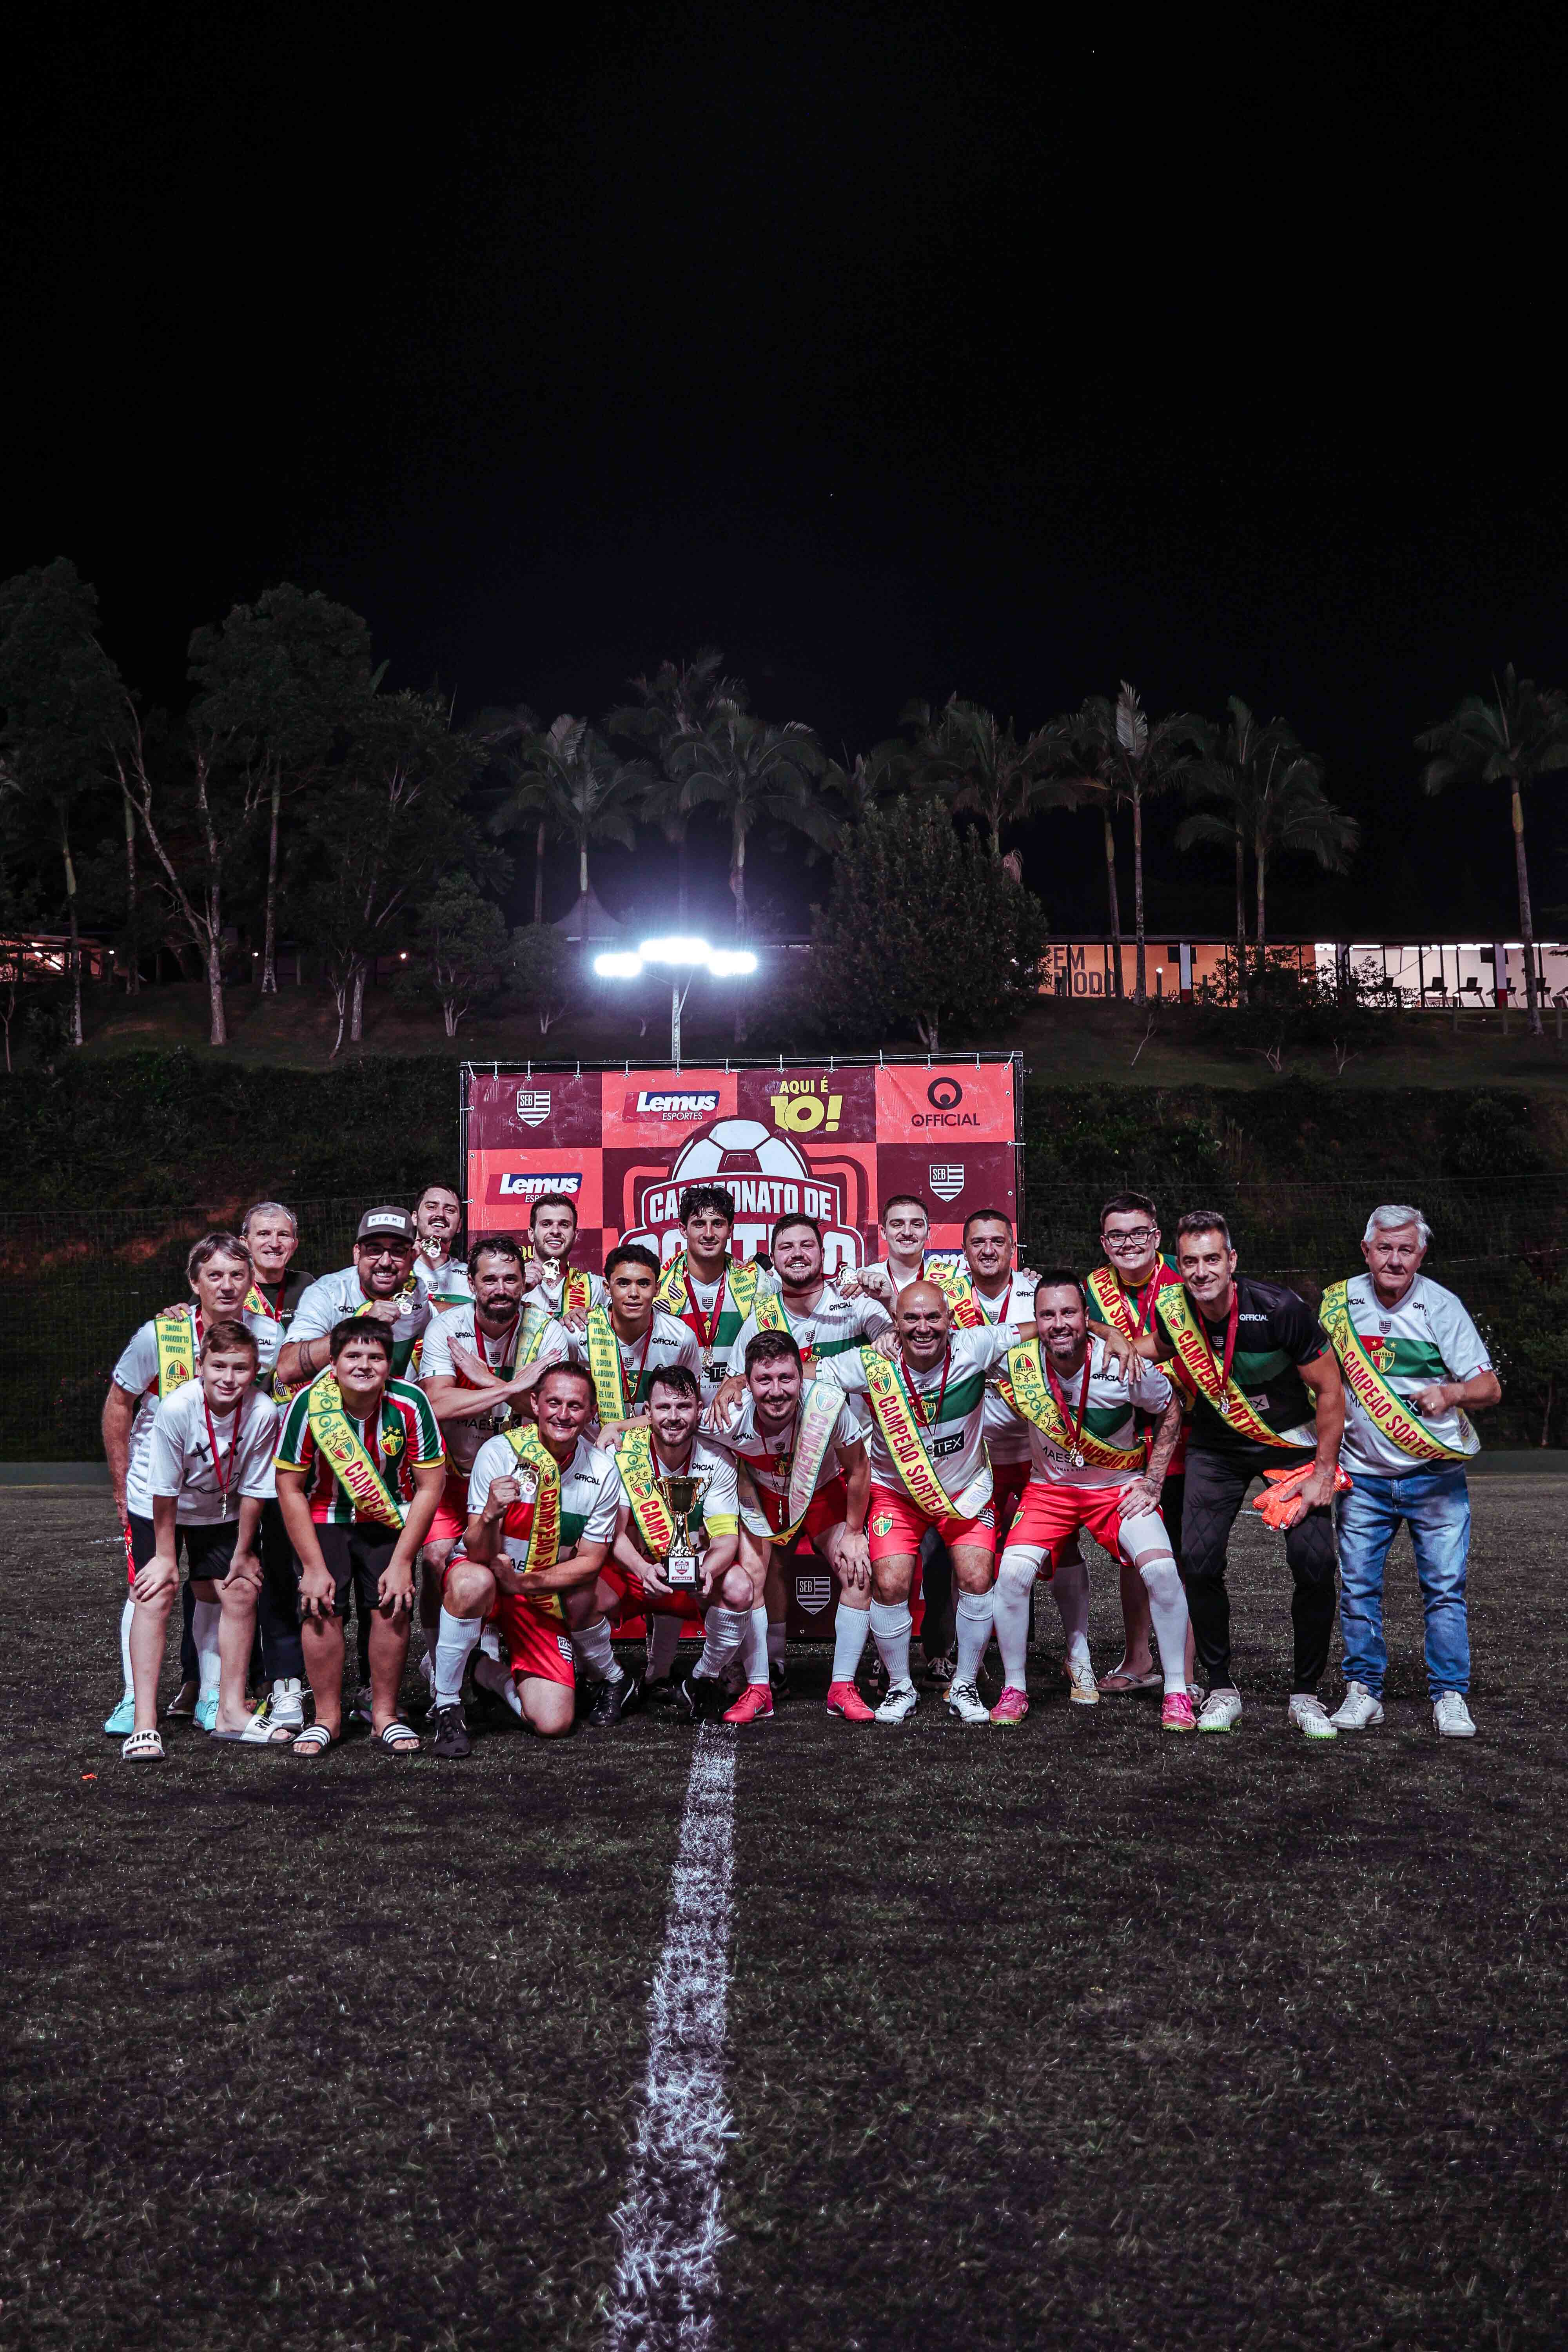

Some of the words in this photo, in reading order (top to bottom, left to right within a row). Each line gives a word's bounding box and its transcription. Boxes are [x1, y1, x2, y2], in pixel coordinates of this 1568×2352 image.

[780, 1080, 815, 1093] AQUI
[821, 1076, 828, 1093] É
[520, 1095, 533, 1106] SEB
[636, 1091, 717, 1112] Lemus
[662, 1112, 703, 1121] ESPORTES
[771, 1095, 842, 1132] 10!
[911, 1114, 980, 1127] OFFICIAL
[933, 1169, 946, 1180] SEB
[499, 1174, 579, 1194] Lemus
[804, 1188, 831, 1221] DE
[829, 1301, 852, 1311] OFFICIAL
[652, 1338, 679, 1347] OFFICIAL
[1092, 1373, 1120, 1382] OFFICIA
[1343, 1351, 1392, 1419] CAMPEÃO
[878, 1396, 922, 1464] CAMPEÃO
[535, 1488, 559, 1556] CAMPEÃO
[639, 1500, 671, 1557] CAMPE
[799, 1581, 813, 1592] SEB
[558, 1637, 567, 1648] SEB
[124, 1731, 161, 1747] NIKE
